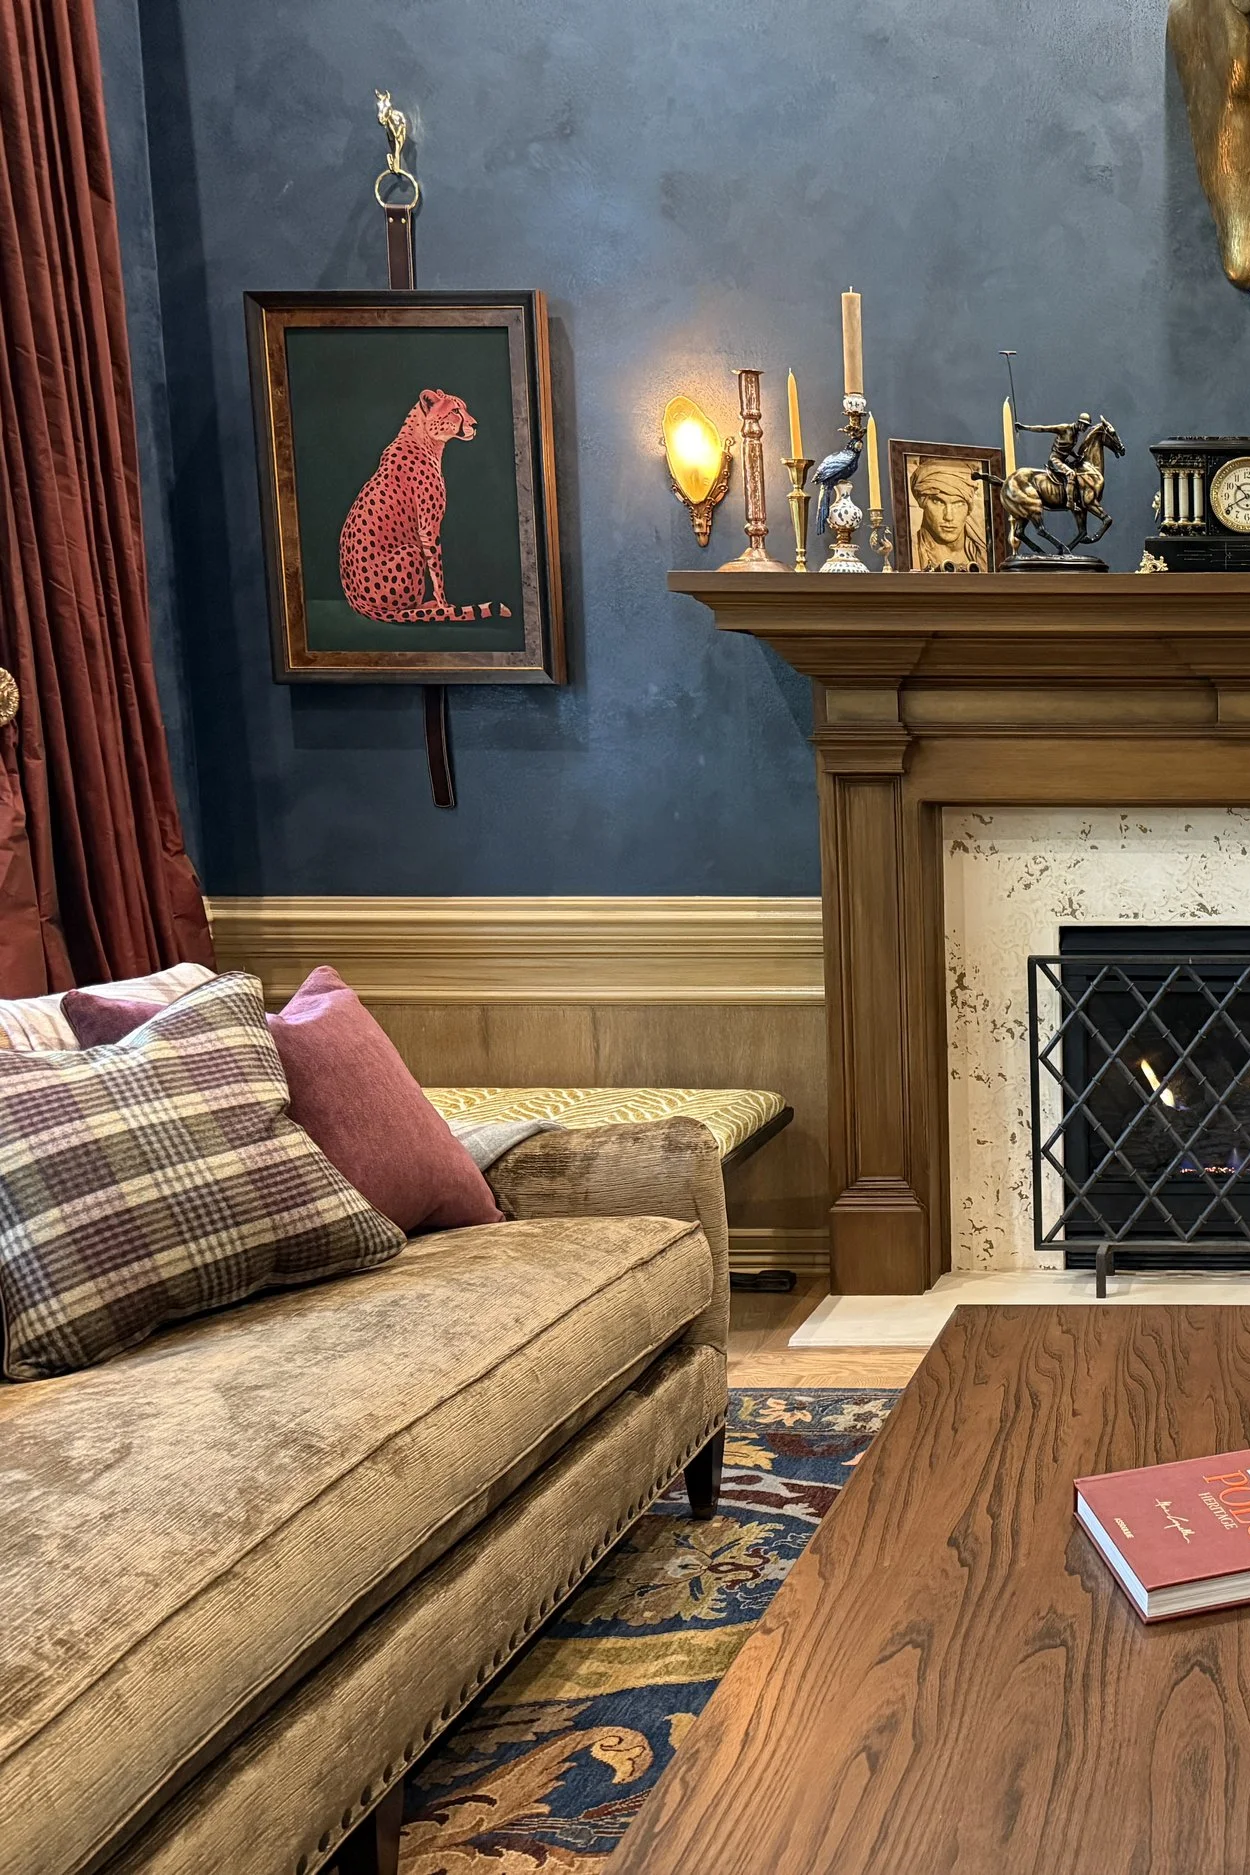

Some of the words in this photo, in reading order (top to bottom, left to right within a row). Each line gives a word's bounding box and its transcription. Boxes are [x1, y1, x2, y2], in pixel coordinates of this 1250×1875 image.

[1234, 474, 1240, 482] 11
[1243, 471, 1250, 479] 12
[1226, 482, 1234, 490] 10
[1224, 492, 1230, 500] 9
[1235, 510, 1240, 519] 7
[1243, 513, 1250, 521] 6
[1198, 1491, 1239, 1530] HERITAGE
